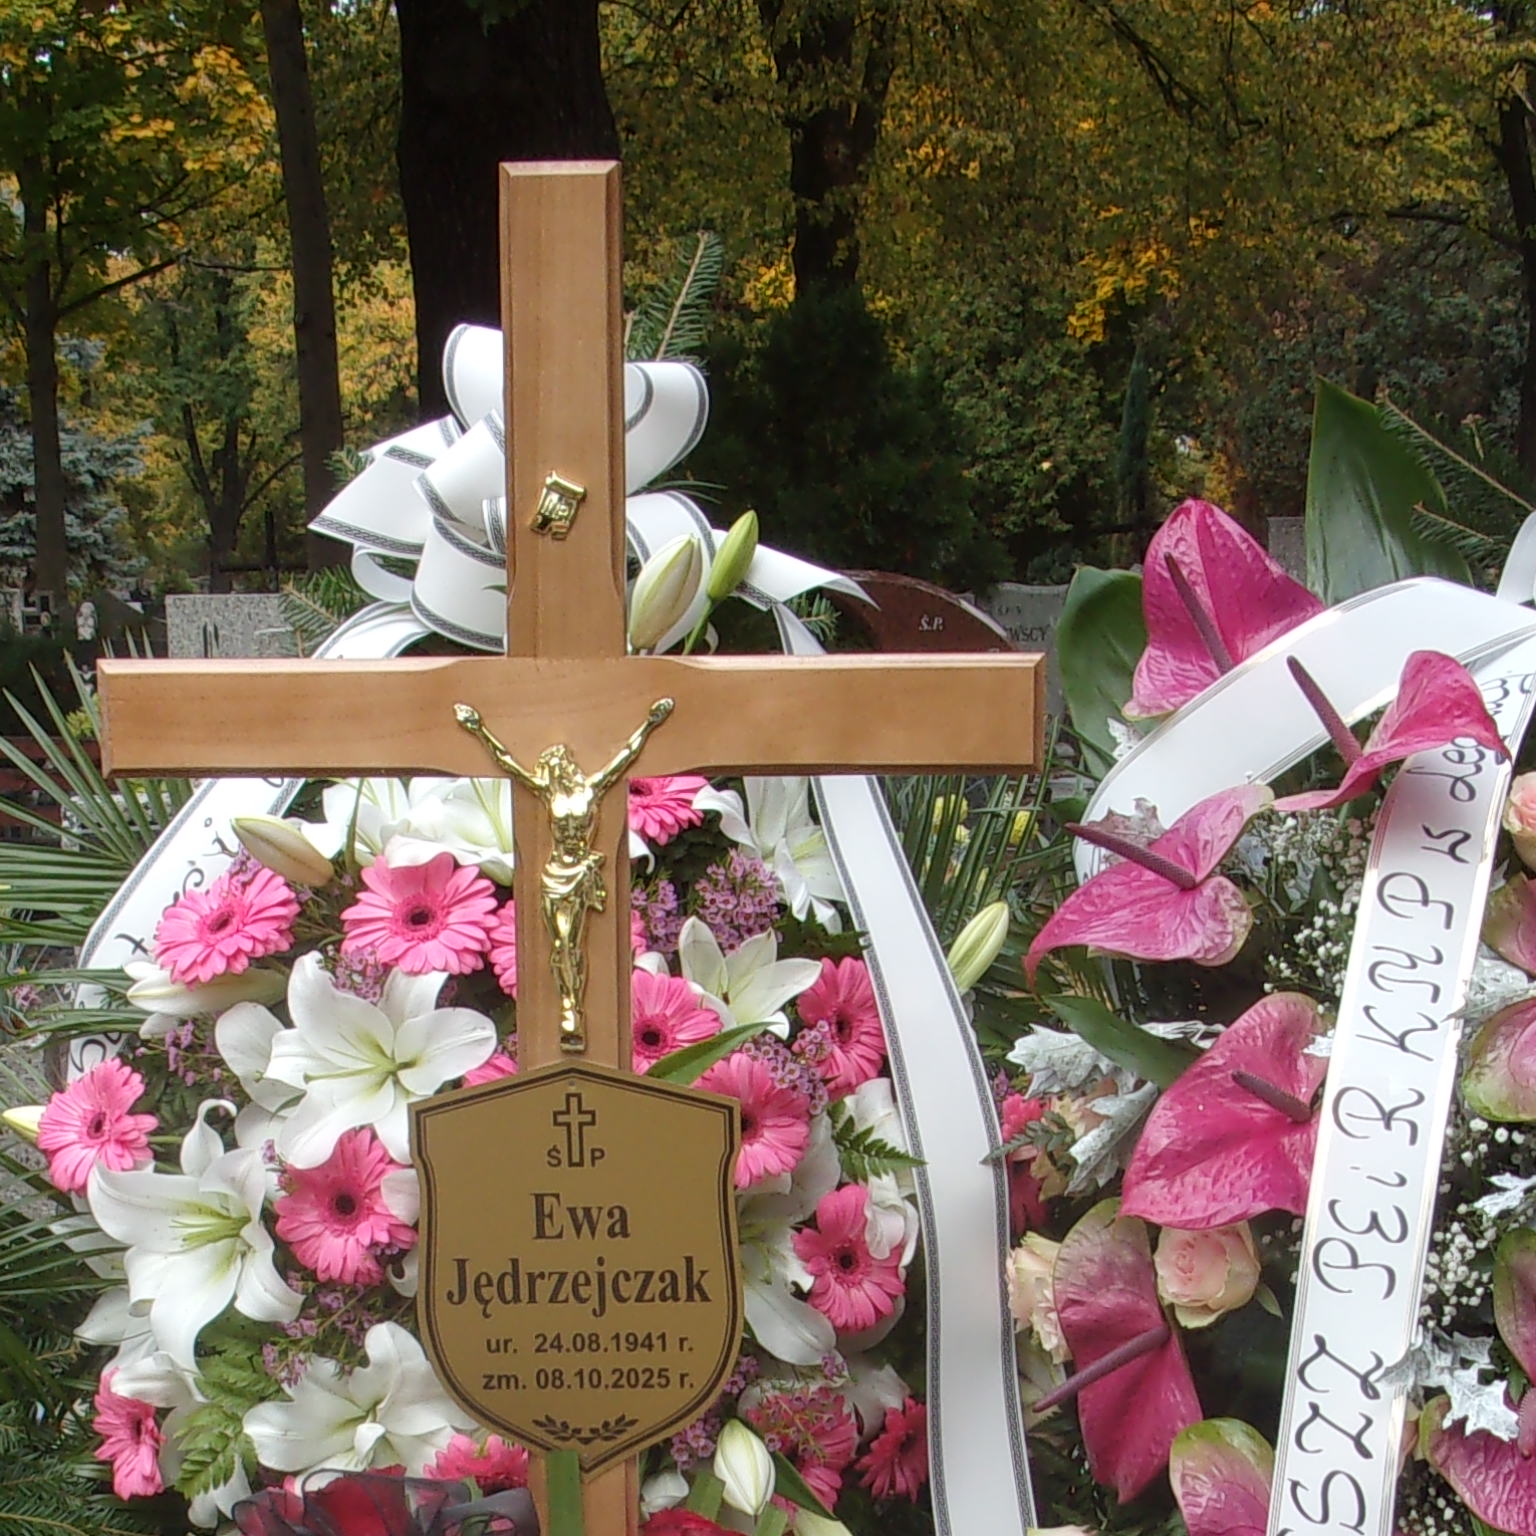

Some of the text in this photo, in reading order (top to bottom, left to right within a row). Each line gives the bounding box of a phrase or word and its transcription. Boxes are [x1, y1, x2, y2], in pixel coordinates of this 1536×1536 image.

[530, 1192, 632, 1241] Ewa
[446, 1255, 713, 1319] Jędrzejczak
[485, 1332, 695, 1354] ur. 24.08.1941 r.
[482, 1368, 695, 1390] zm. 08.10.2025 r.
